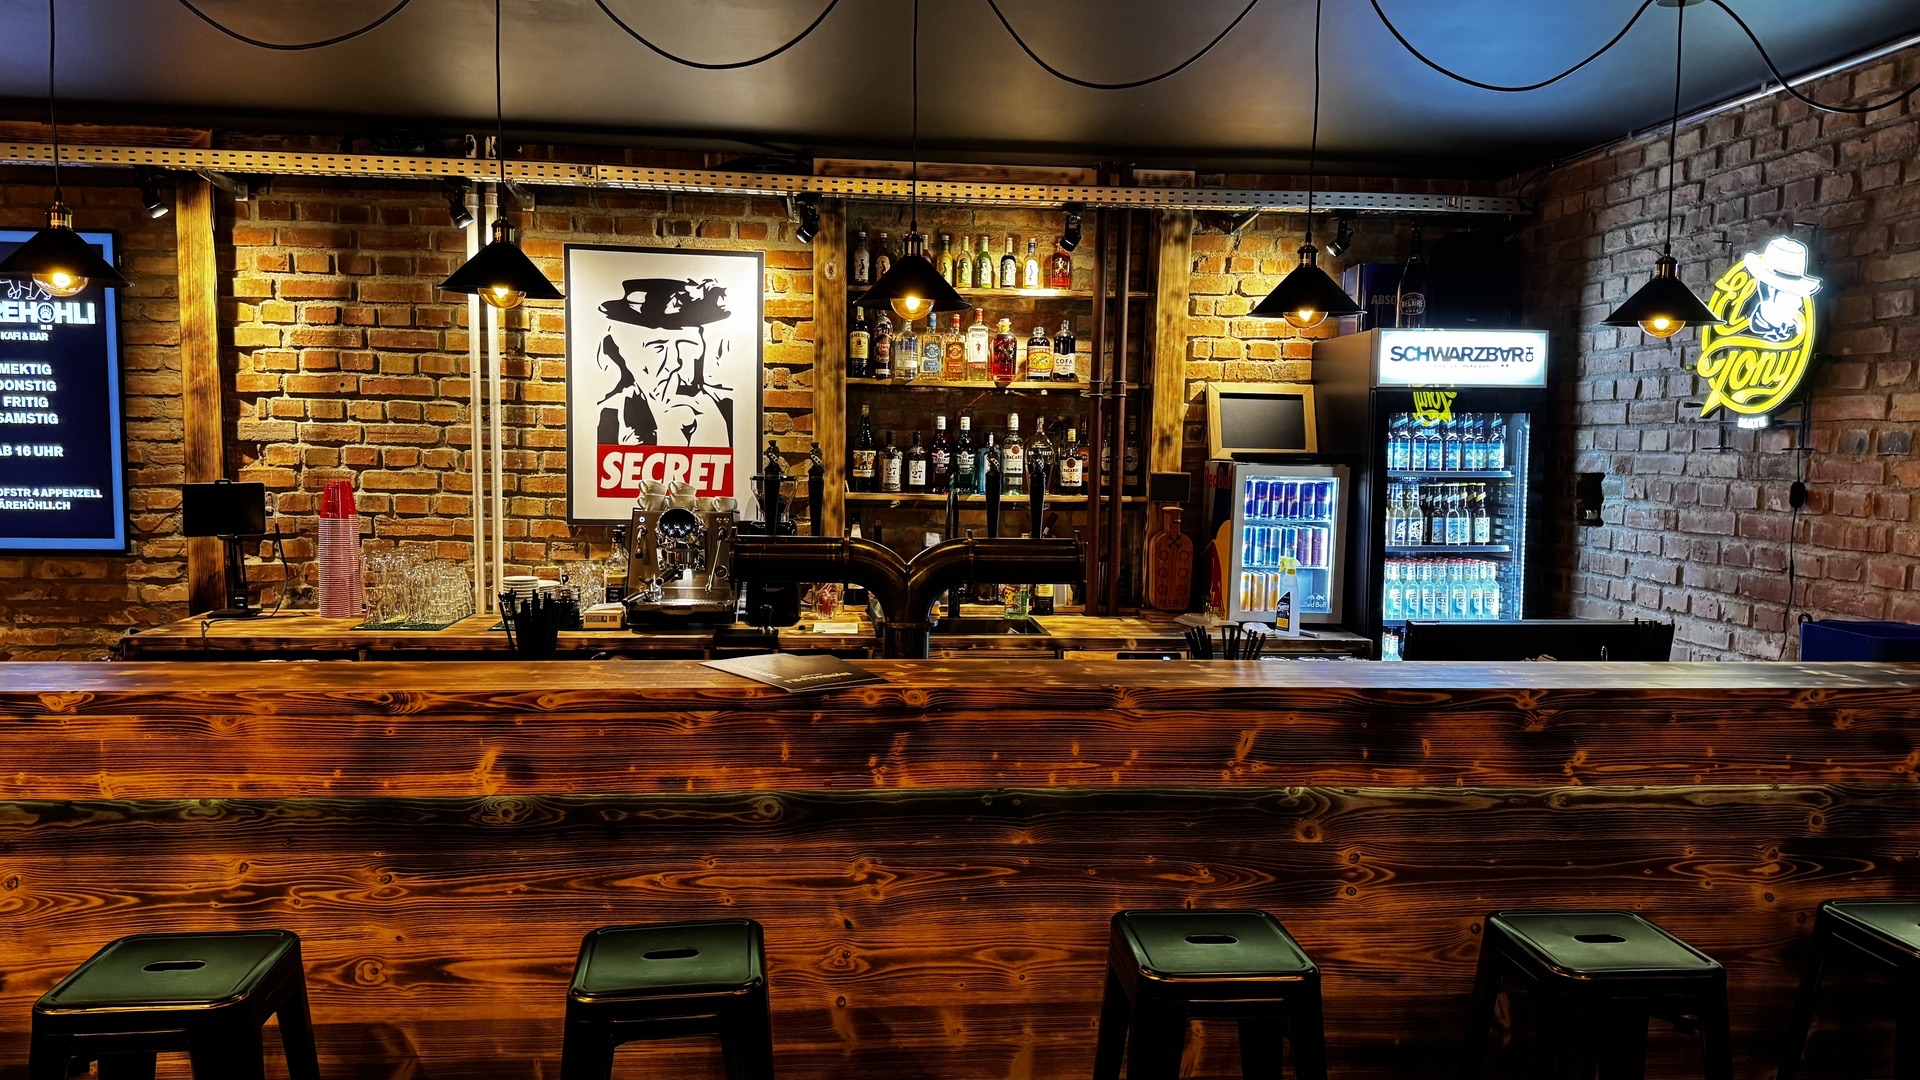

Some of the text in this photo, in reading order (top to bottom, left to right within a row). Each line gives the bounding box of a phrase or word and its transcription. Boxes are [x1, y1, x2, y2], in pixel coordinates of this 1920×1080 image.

[1714, 272, 1757, 335] El
[22, 332, 29, 341] &
[29, 332, 49, 341] BAR
[3, 396, 49, 408] FRITIG
[15, 445, 32, 457] 16
[33, 446, 64, 457] UHR
[600, 452, 731, 491] SECRET
[912, 470, 923, 479] 27
[32, 488, 40, 497] 4
[41, 489, 103, 498] APPENZELL
